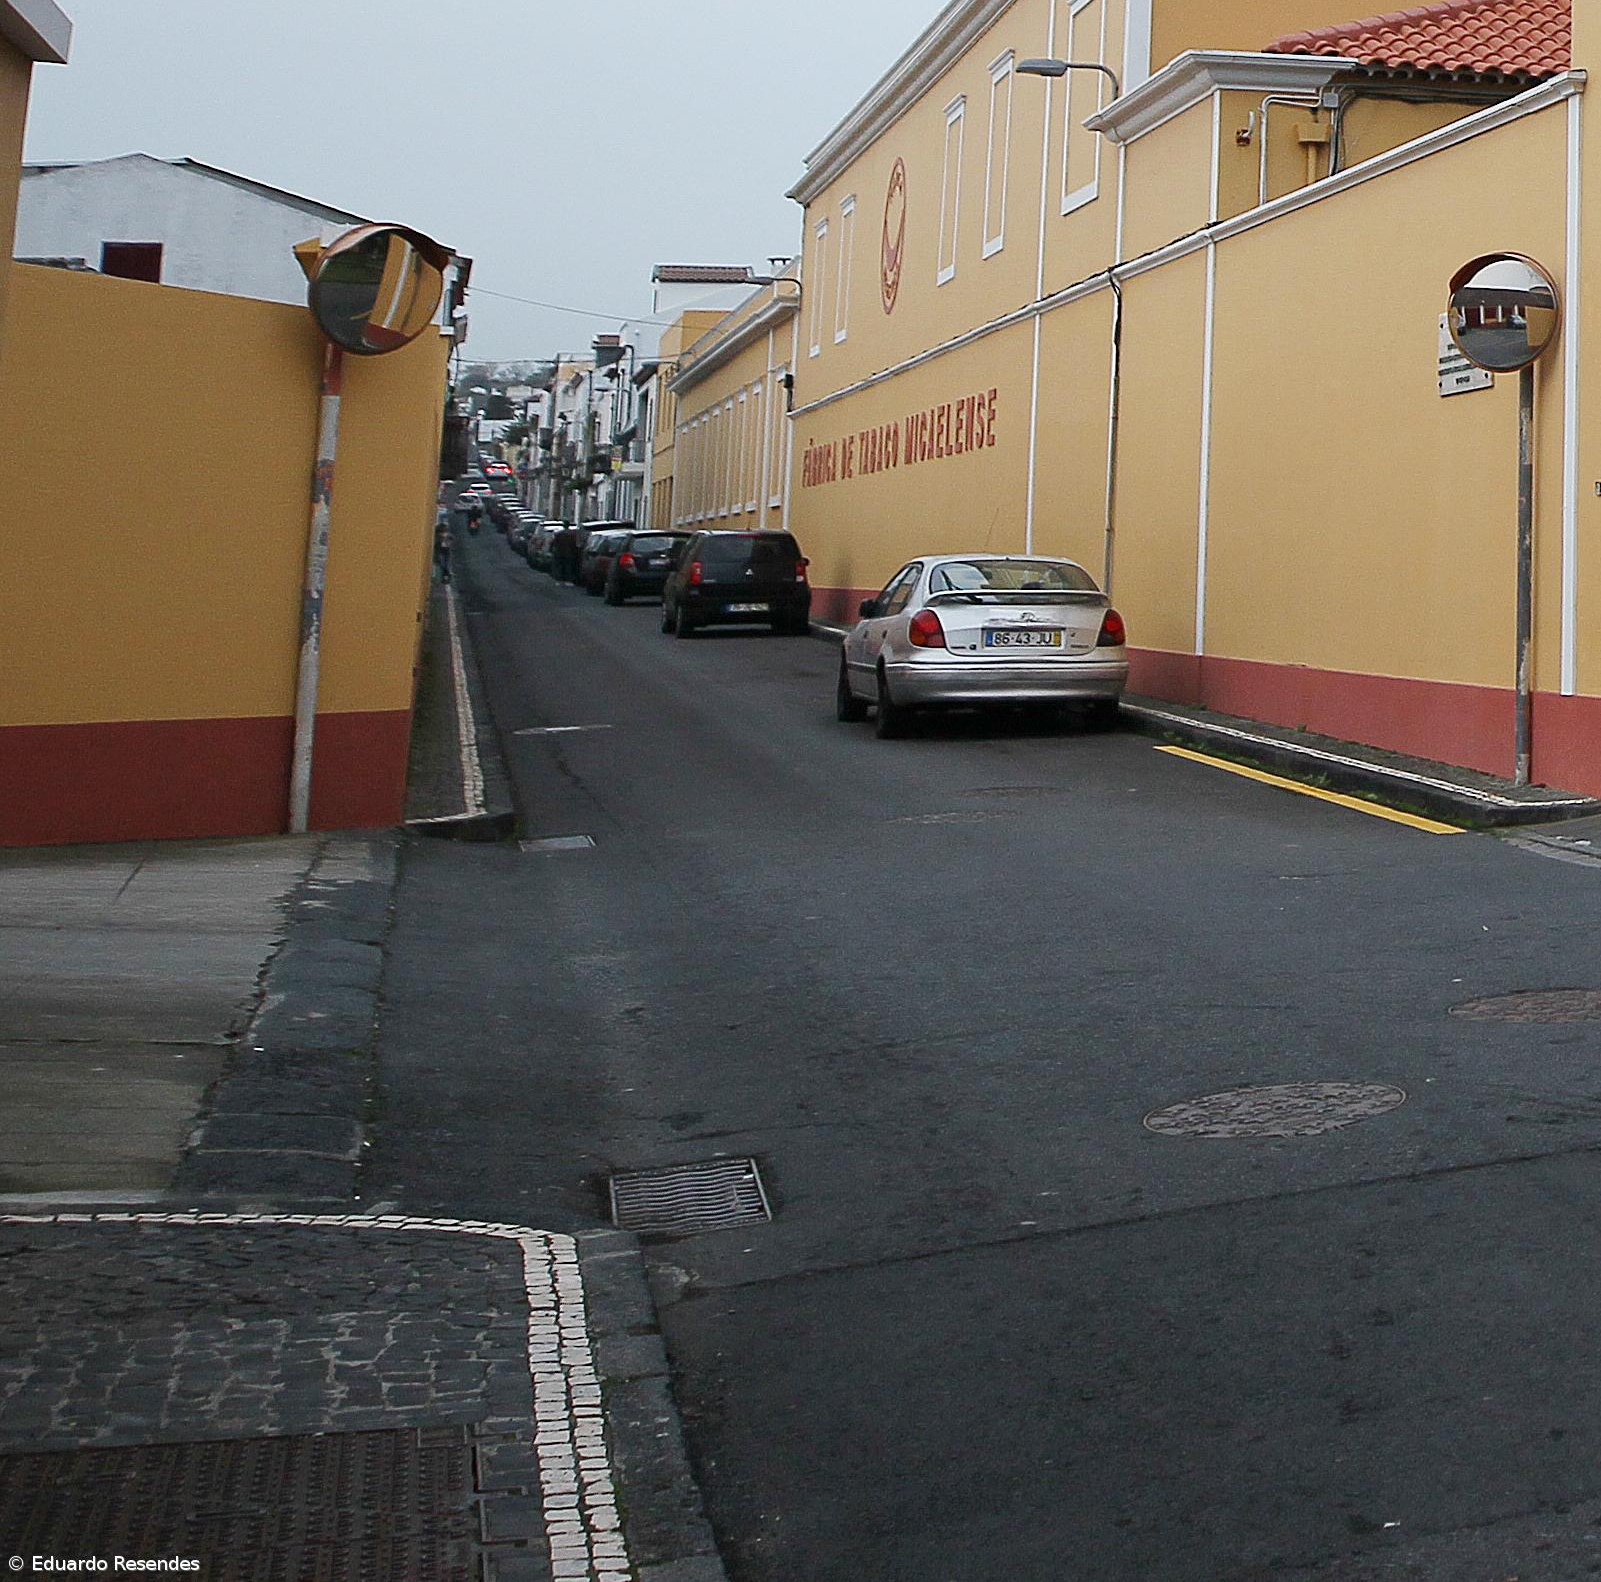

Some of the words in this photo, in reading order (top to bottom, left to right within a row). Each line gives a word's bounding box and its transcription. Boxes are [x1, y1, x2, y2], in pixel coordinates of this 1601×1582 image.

[841, 435, 854, 480] DE
[858, 420, 899, 475] TABACO
[904, 388, 997, 465] MICAELENSE
